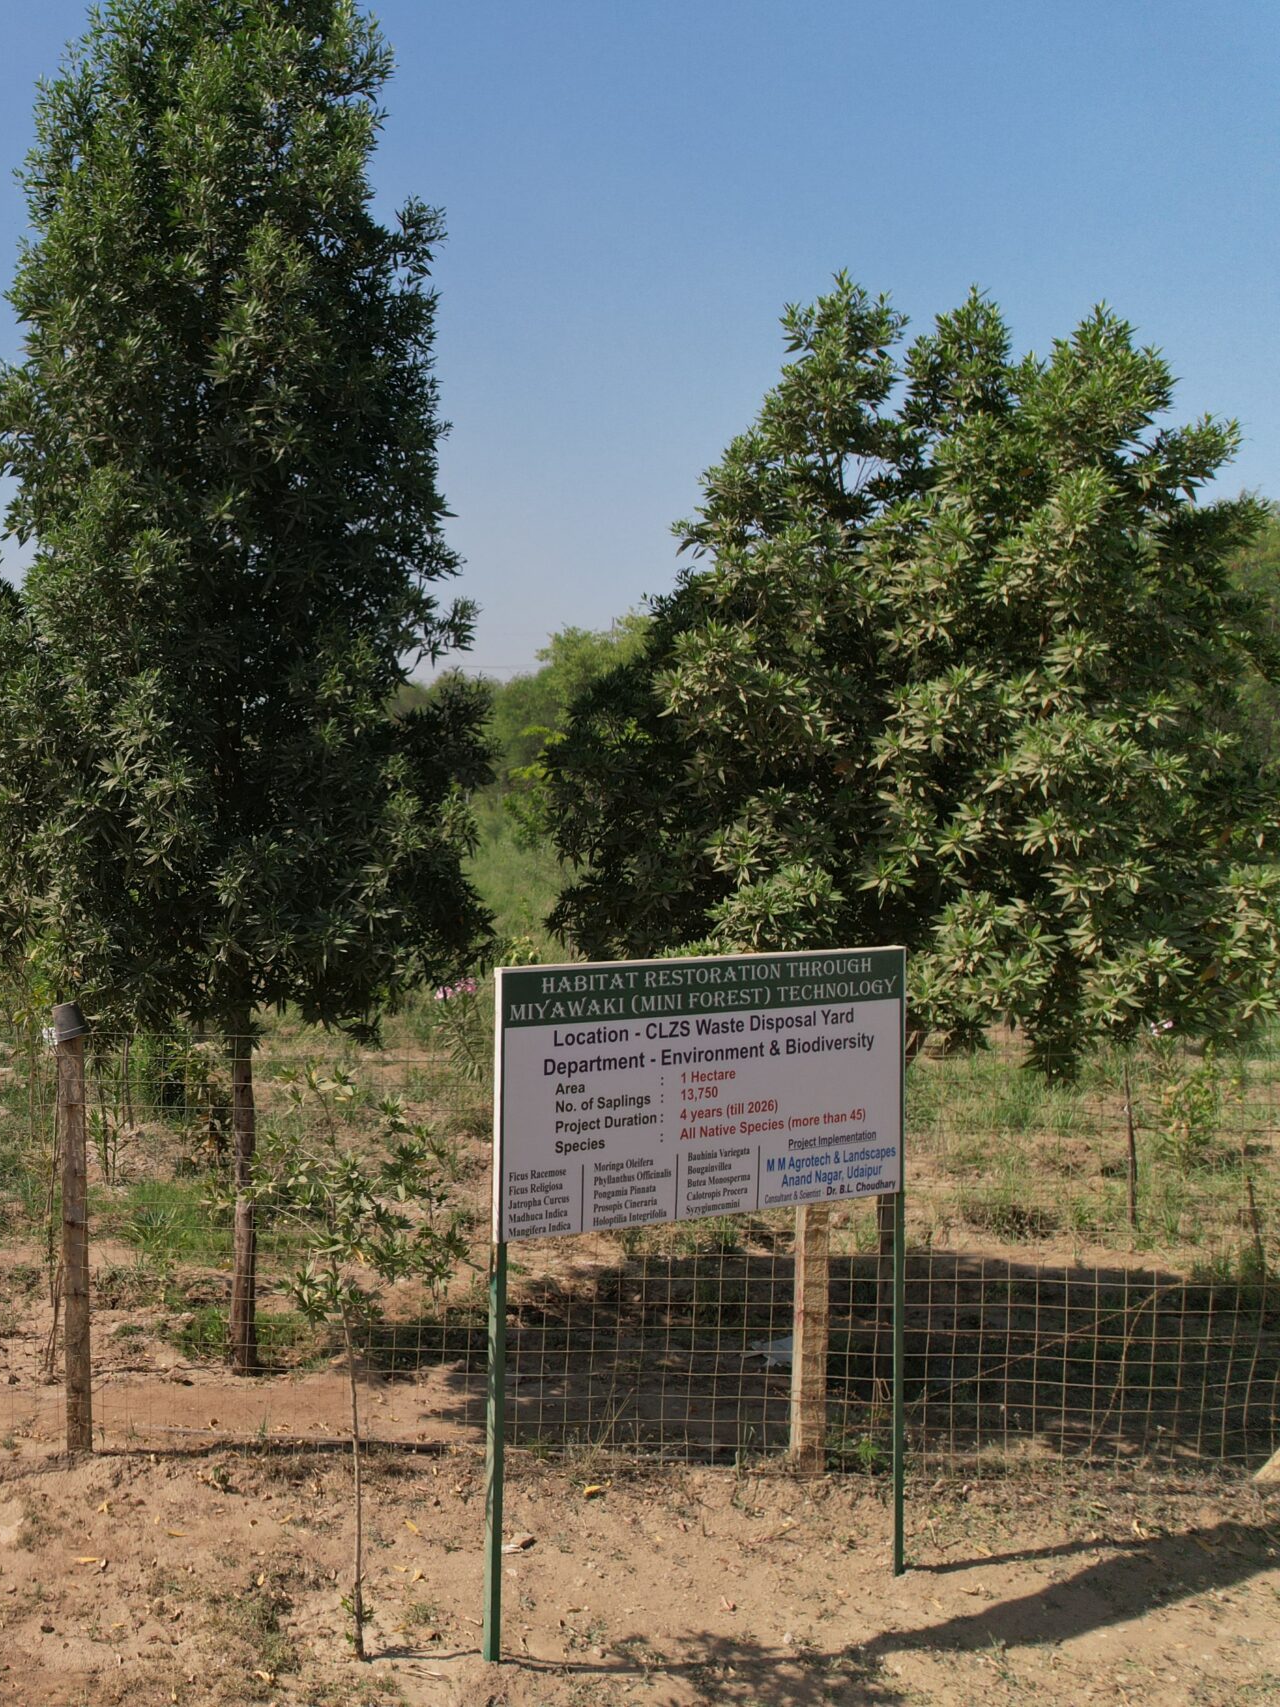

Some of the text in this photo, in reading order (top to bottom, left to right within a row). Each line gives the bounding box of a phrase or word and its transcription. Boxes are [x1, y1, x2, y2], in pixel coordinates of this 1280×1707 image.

[542, 958, 872, 994] HABITAT RESTORATION THROUGH
[509, 975, 898, 1021] MIYAWAKI (MINI FOREST) TECHNOLOGY
[554, 1027, 629, 1047] Location
[646, 1021, 690, 1039] CLZS
[696, 1018, 744, 1036] Waste
[750, 1011, 817, 1033] Disposal
[821, 1008, 854, 1025] Yard
[544, 1052, 645, 1078] Department
[661, 1042, 764, 1065] Environment
[770, 1040, 780, 1056] &
[786, 1033, 874, 1055] Biodiversity
[555, 1083, 585, 1095] Area
[681, 1072, 686, 1083] 1
[691, 1070, 736, 1082] Hectare
[556, 1101, 576, 1113] No.
[581, 1098, 593, 1110] of
[597, 1093, 651, 1109] Saplings
[681, 1086, 718, 1101] 13,750
[556, 1118, 600, 1135] Project
[604, 1113, 657, 1128] Duration
[680, 1109, 687, 1120] 4
[691, 1107, 722, 1123] years
[727, 1103, 744, 1118] (till
[748, 1100, 778, 1114] 2026)
[555, 1138, 605, 1155] Species
[680, 1127, 695, 1140] All
[700, 1125, 736, 1138] Native
[740, 1119, 784, 1135] Species
[788, 1115, 820, 1131] (more
[823, 1112, 847, 1124] than
[850, 1108, 866, 1122] 45)
[789, 1131, 876, 1150] Project Implementation
[688, 1147, 750, 1161] Bauhinia Variegata
[767, 1146, 896, 1172] M M Agrotech & Landscapes
[594, 1158, 653, 1172] Moringa Oleifera
[688, 1162, 731, 1175] Bougainvillea
[509, 1169, 566, 1182] Ficus Racemose
[594, 1168, 671, 1187] Phyllanthus Officinalis
[782, 1171, 812, 1188] Anand
[847, 1165, 882, 1179] Udaipur
[509, 1182, 563, 1196] Ficus Religiosa
[594, 1184, 656, 1200] Pongamia Pinnata
[826, 1187, 837, 1196] Dr.
[856, 1180, 895, 1192] Choudhary
[545, 1209, 568, 1219] Indica
[509, 1222, 571, 1238] Mangifera Indica
